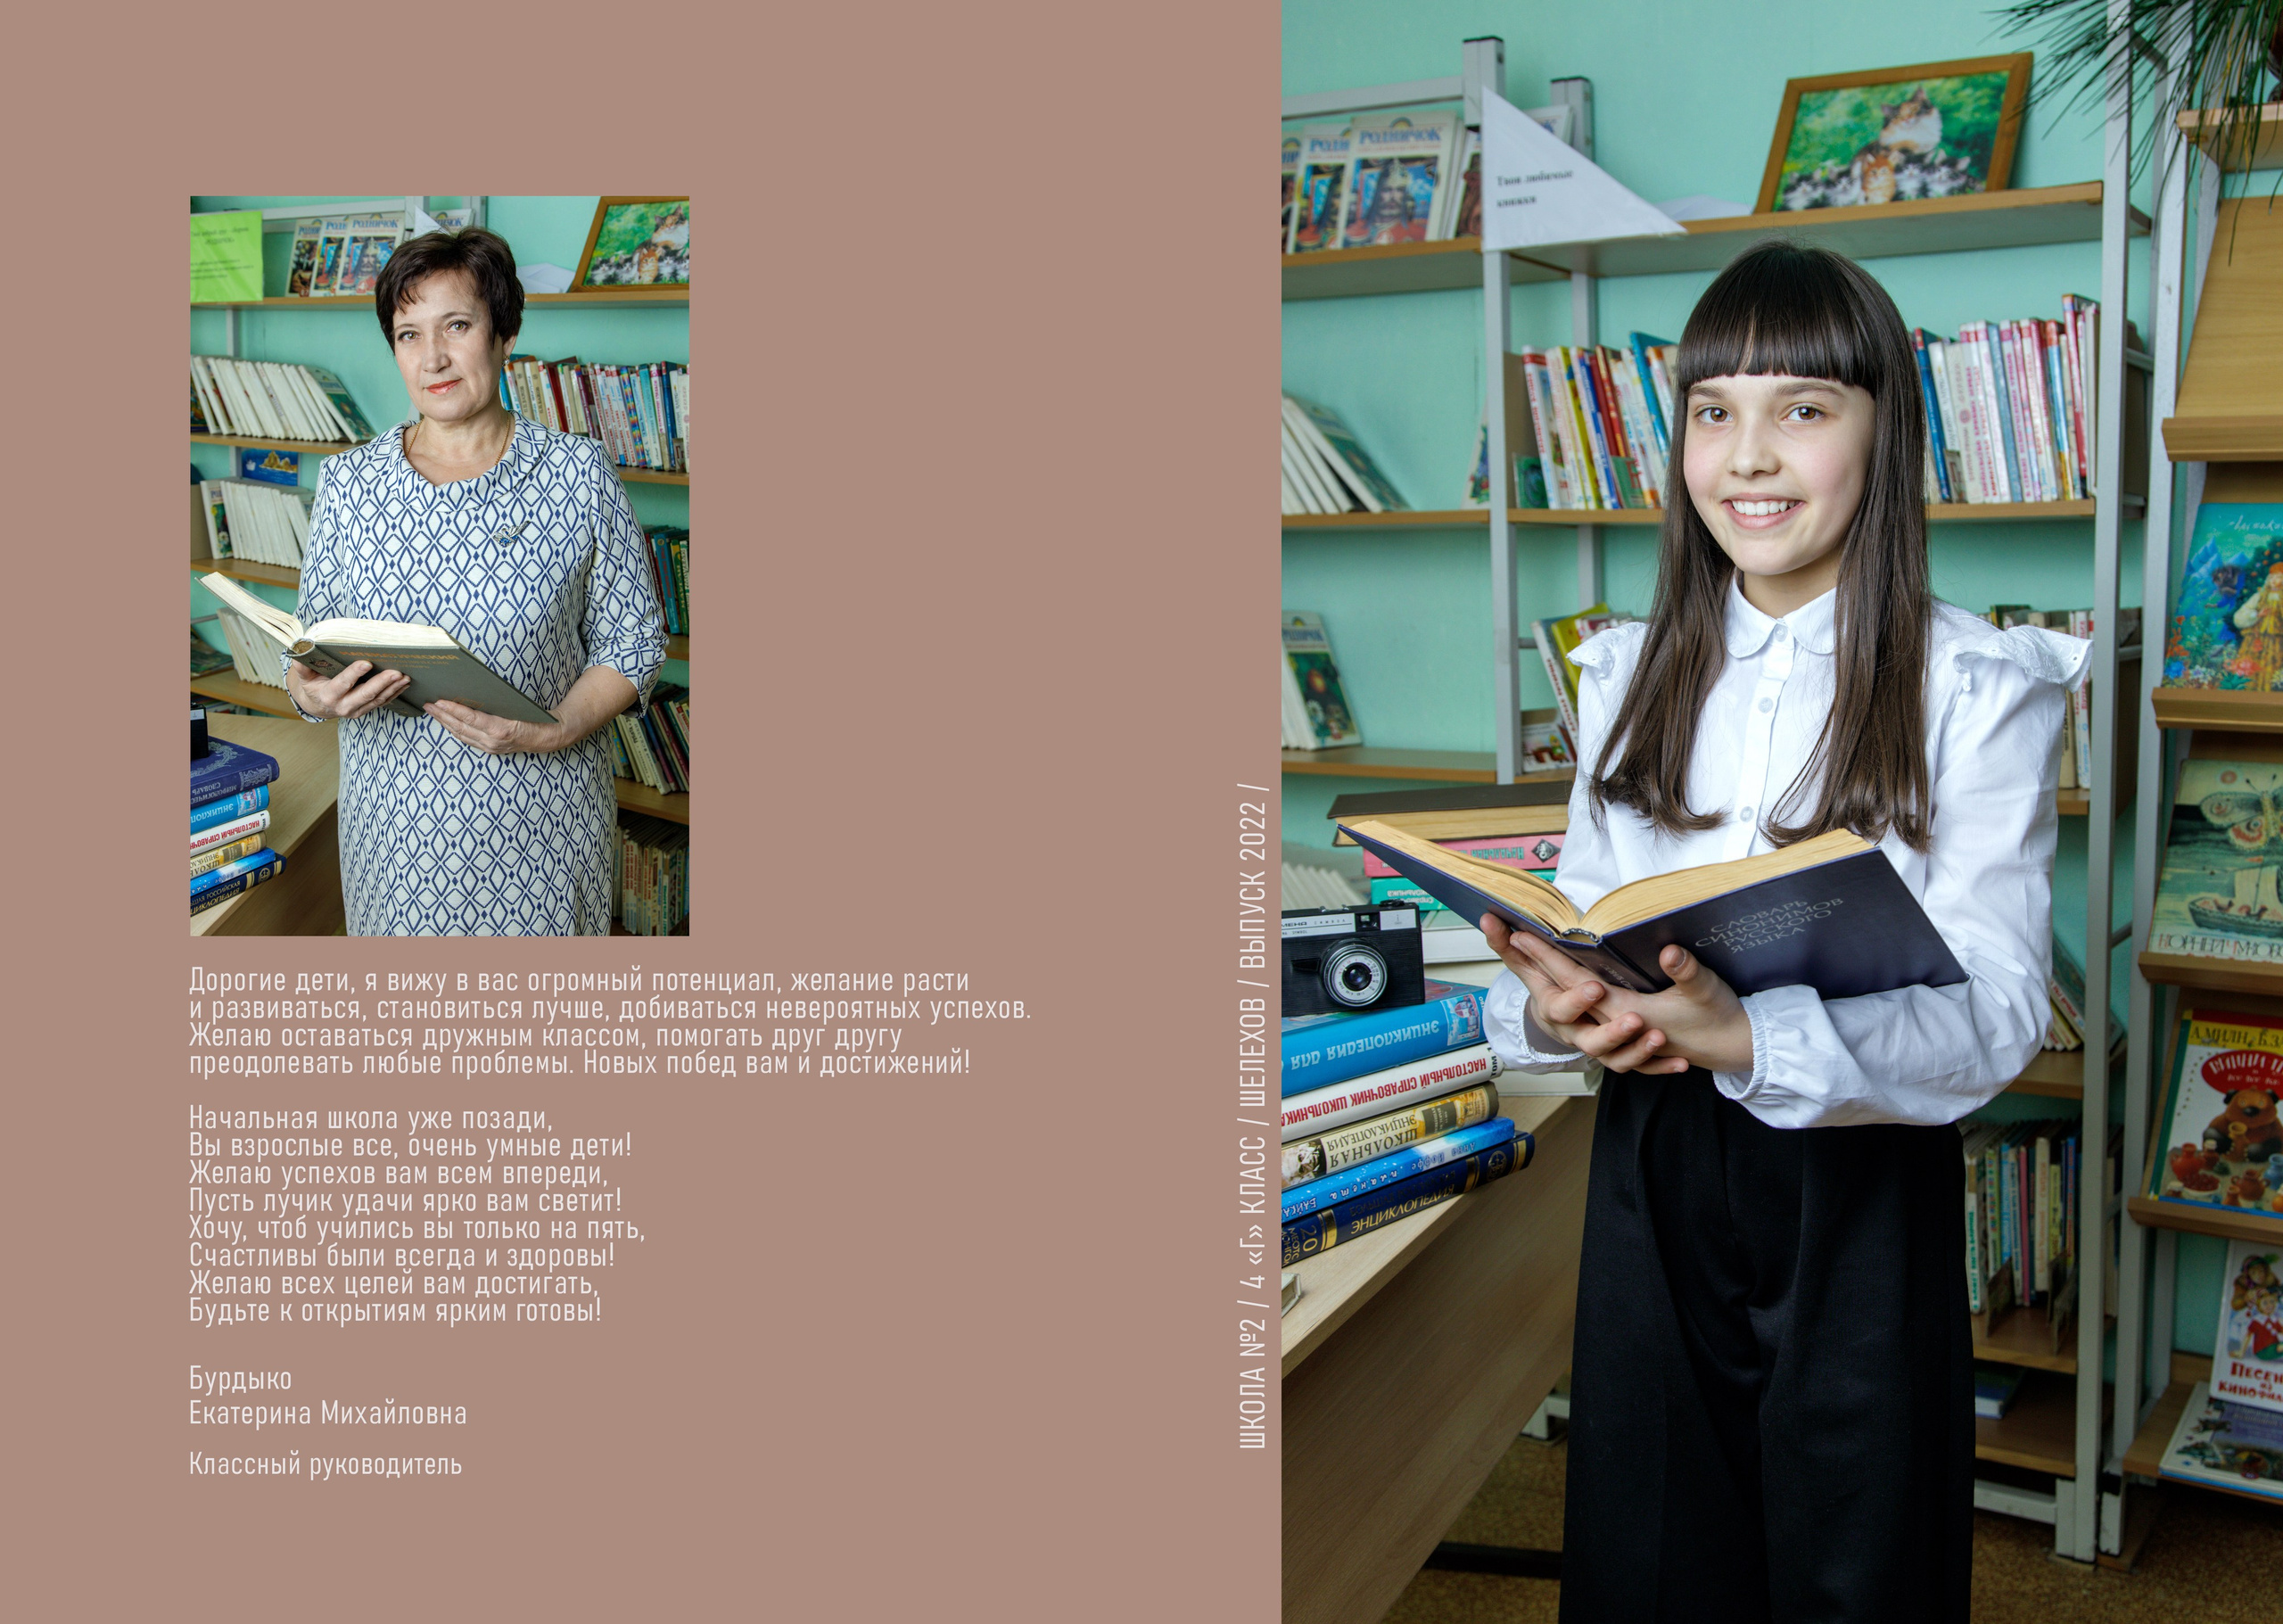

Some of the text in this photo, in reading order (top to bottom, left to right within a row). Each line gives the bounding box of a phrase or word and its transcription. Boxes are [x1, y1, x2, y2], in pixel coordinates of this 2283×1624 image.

[192, 782, 221, 795] СЛОВАРЬ
[221, 820, 260, 840] НАСТОЛЬНЫЙ
[1694, 898, 1844, 947] СИНОНИМОВ
[1710, 900, 1809, 934] СЛОВАРЬ
[1723, 910, 1832, 947] РУССКОГО
[1730, 927, 1806, 954] ЯЗЫКА
[1290, 1019, 1440, 1070] ЭНЦИКЛОПЕДИЯ ДЛЯ
[1490, 1055, 1498, 1077] ТОМ
[1282, 1058, 1487, 1126] НАСТОЛЬНЫЙ СПРАВОЧНИК ШКОЛЬНИКА
[1326, 1114, 1417, 1151] ЭНЦИКЛОПЕДИЯ
[1329, 1128, 1419, 1168] ШКОЛЬНАЯ
[1282, 1196, 1318, 1221] БАЙКА
[1350, 1183, 1455, 1235] ЭНЦИКЛОПЕДИЯ
[1299, 1224, 1318, 1252] 20
